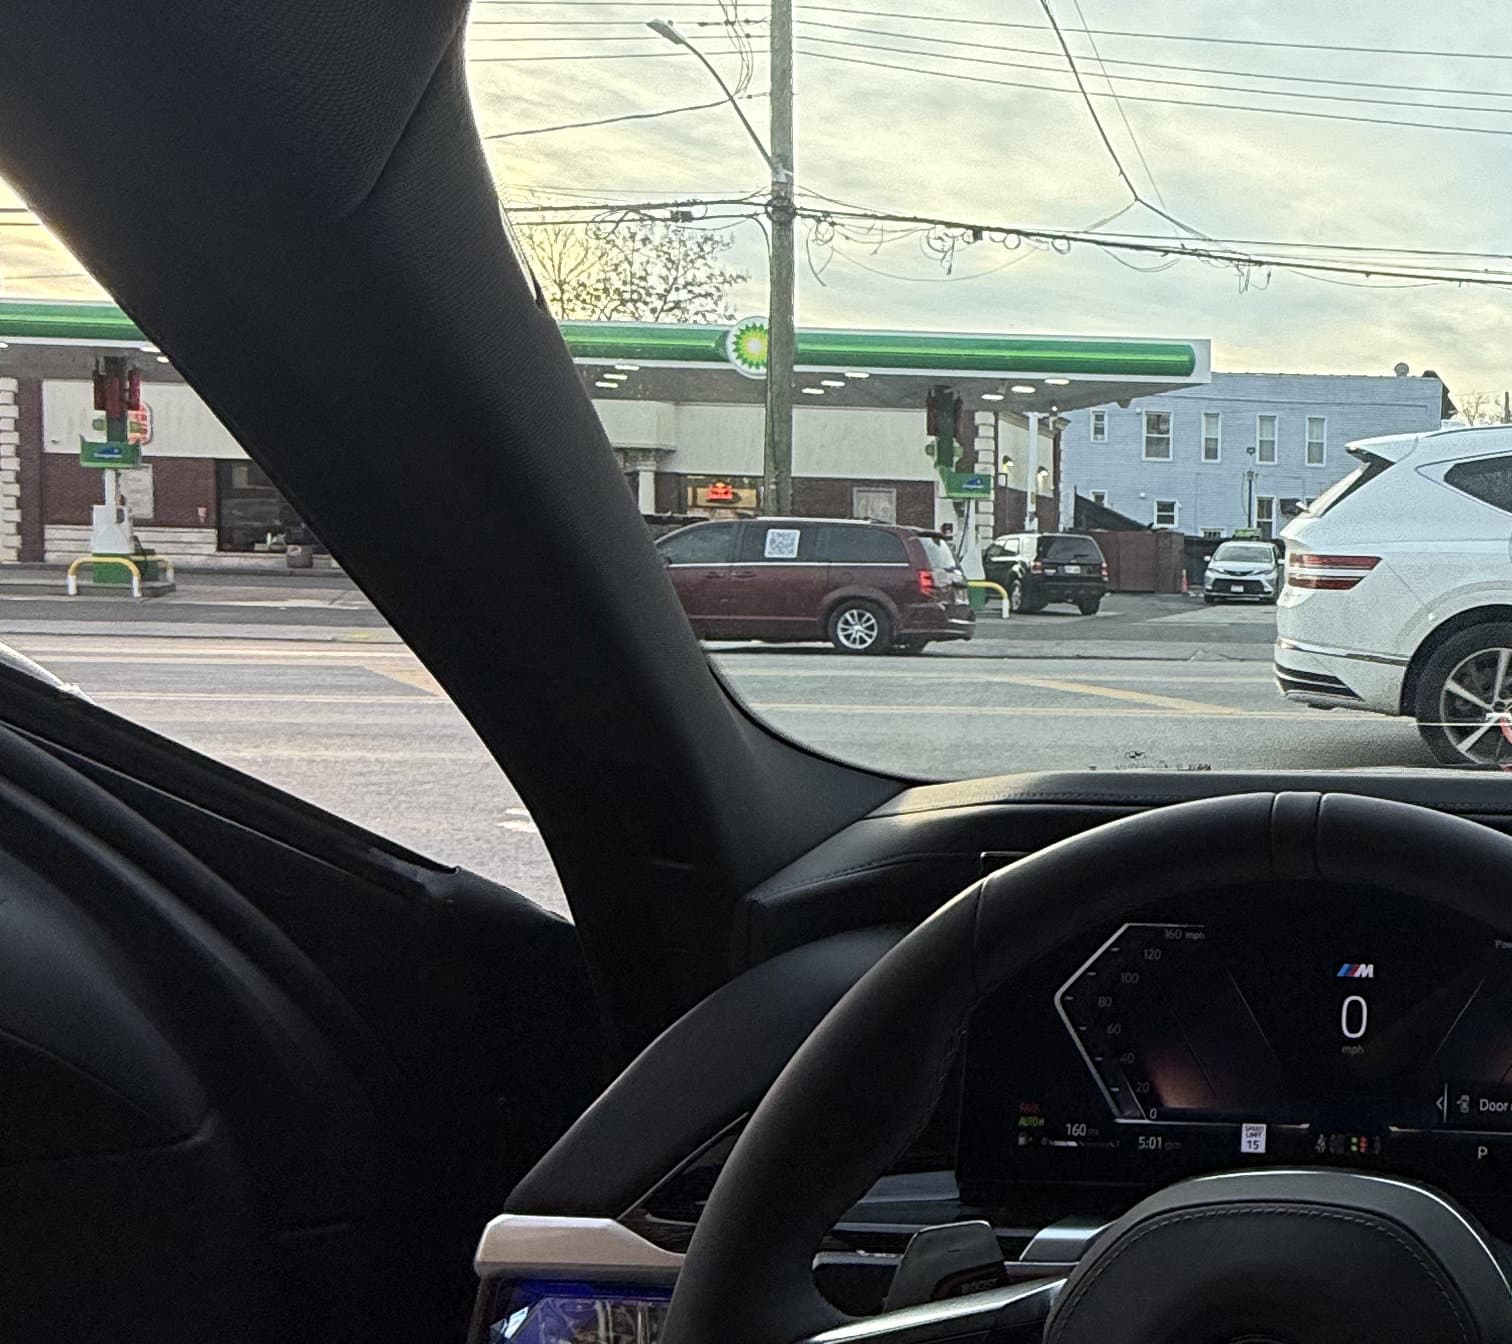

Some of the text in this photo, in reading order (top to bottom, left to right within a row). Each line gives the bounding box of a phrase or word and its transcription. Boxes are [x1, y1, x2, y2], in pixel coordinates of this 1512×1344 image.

[1143, 949, 1162, 960] 120
[1121, 973, 1139, 984] 100
[1098, 997, 1112, 1008] 80
[1341, 995, 1367, 1038] 0
[1107, 1023, 1121, 1035] 60
[1341, 1044, 1364, 1055] mph
[1479, 1099, 1508, 1112] Door
[1150, 1107, 1157, 1119] 0
[1066, 1123, 1087, 1136] 160
[1138, 1136, 1163, 1149] 5:01
[1246, 1140, 1259, 1150] 15
[1477, 1146, 1488, 1159] P
